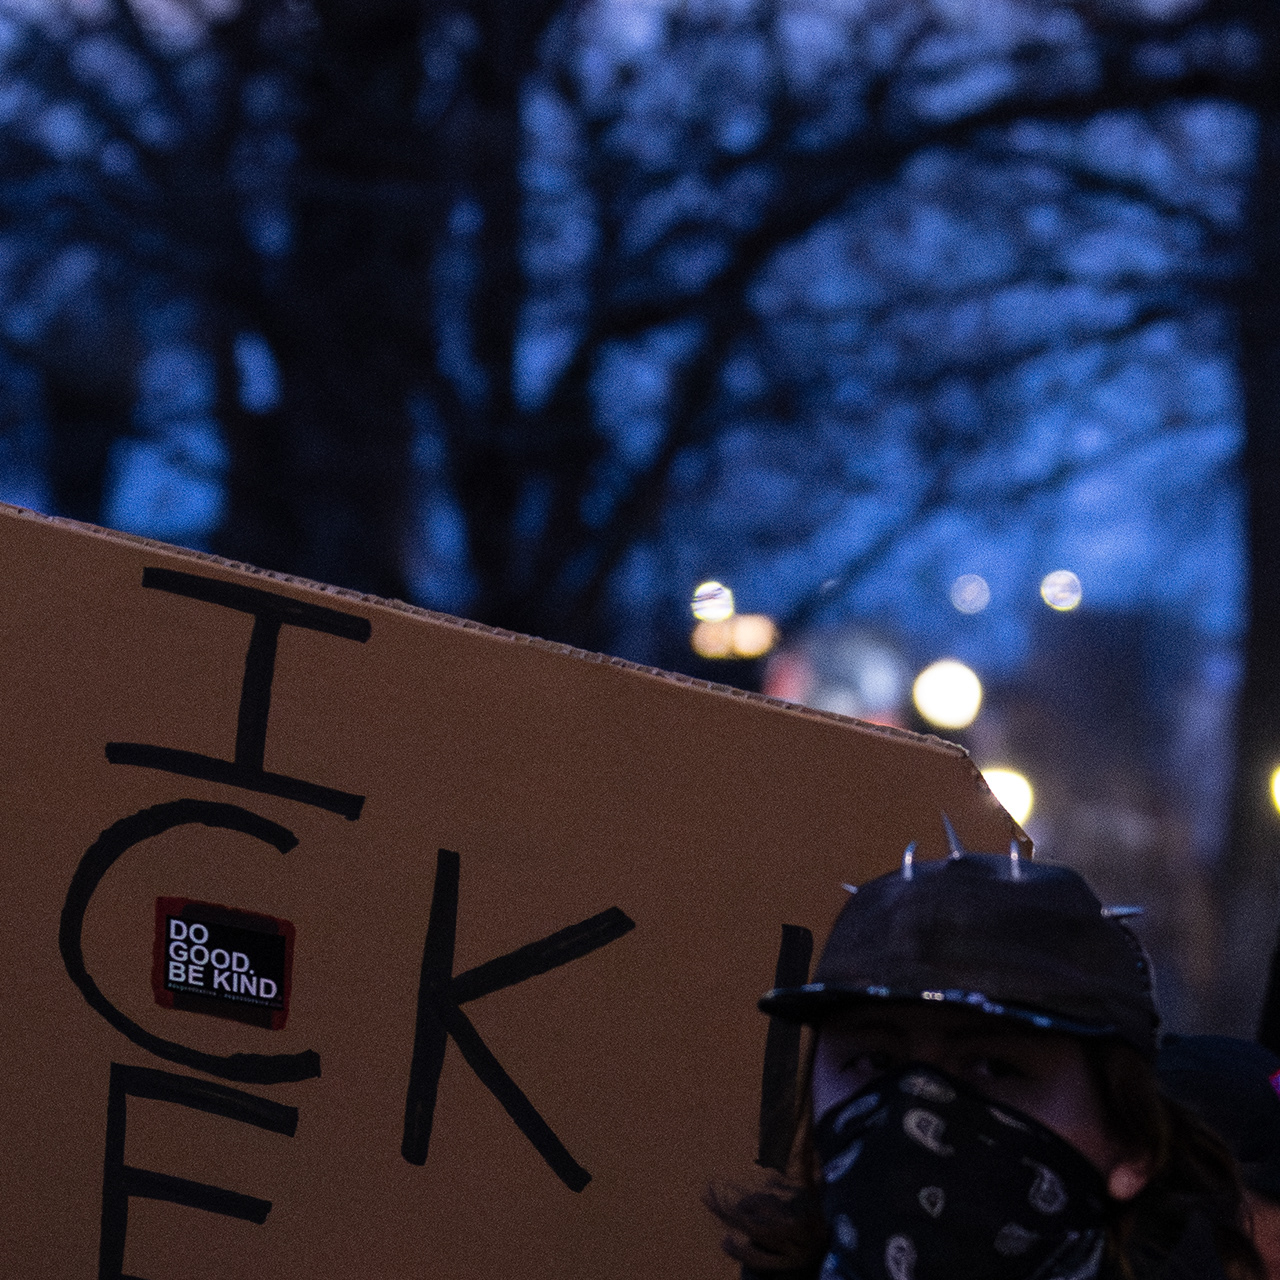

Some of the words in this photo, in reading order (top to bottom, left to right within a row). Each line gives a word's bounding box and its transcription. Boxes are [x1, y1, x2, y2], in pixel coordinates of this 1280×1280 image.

[169, 918, 209, 945] DO
[169, 940, 254, 975] GOOD.
[168, 960, 205, 987] BE
